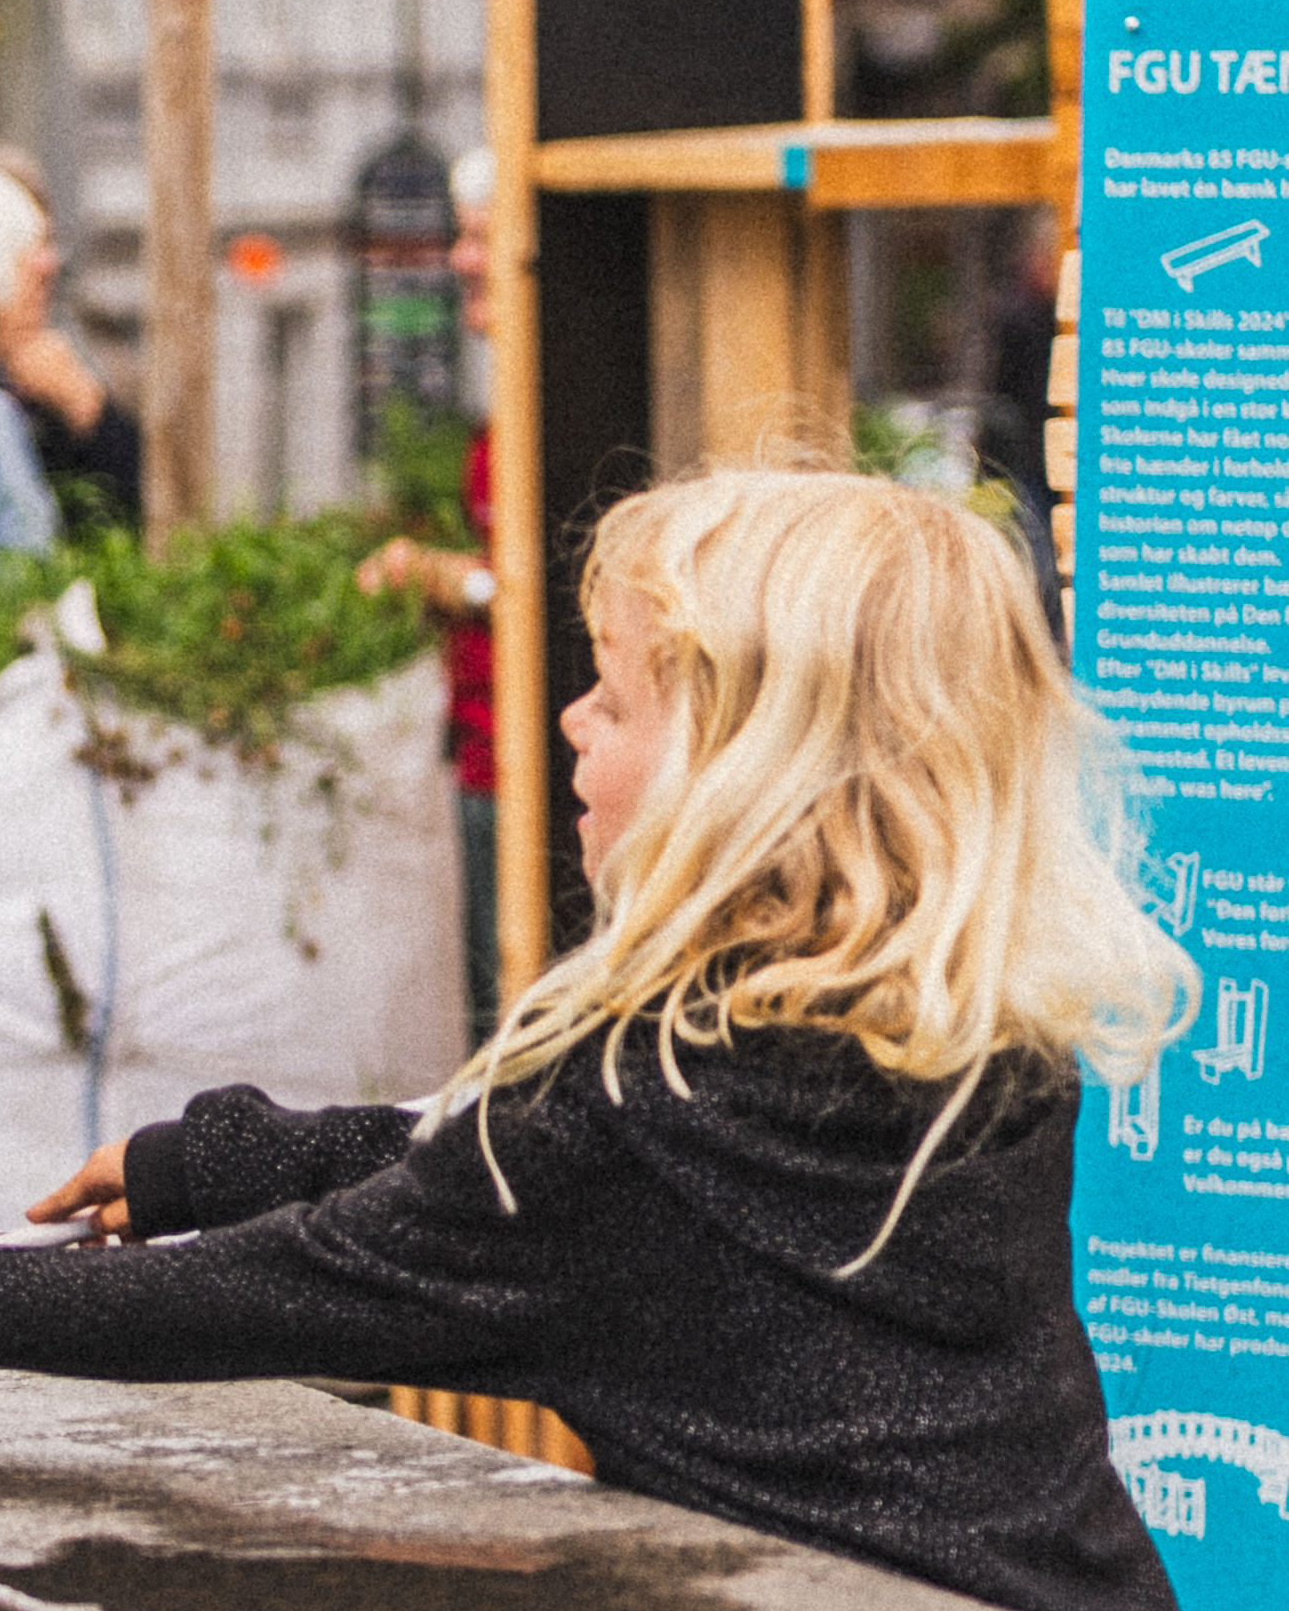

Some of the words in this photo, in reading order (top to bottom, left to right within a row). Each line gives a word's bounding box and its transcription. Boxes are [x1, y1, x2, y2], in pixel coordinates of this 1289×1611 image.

[1109, 50, 1200, 94] FGU
[1105, 178, 1138, 197] har
[1173, 309, 1181, 328] i
[1151, 369, 1199, 388] skole
[1180, 490, 1204, 510] og
[1203, 870, 1243, 890] FGU
